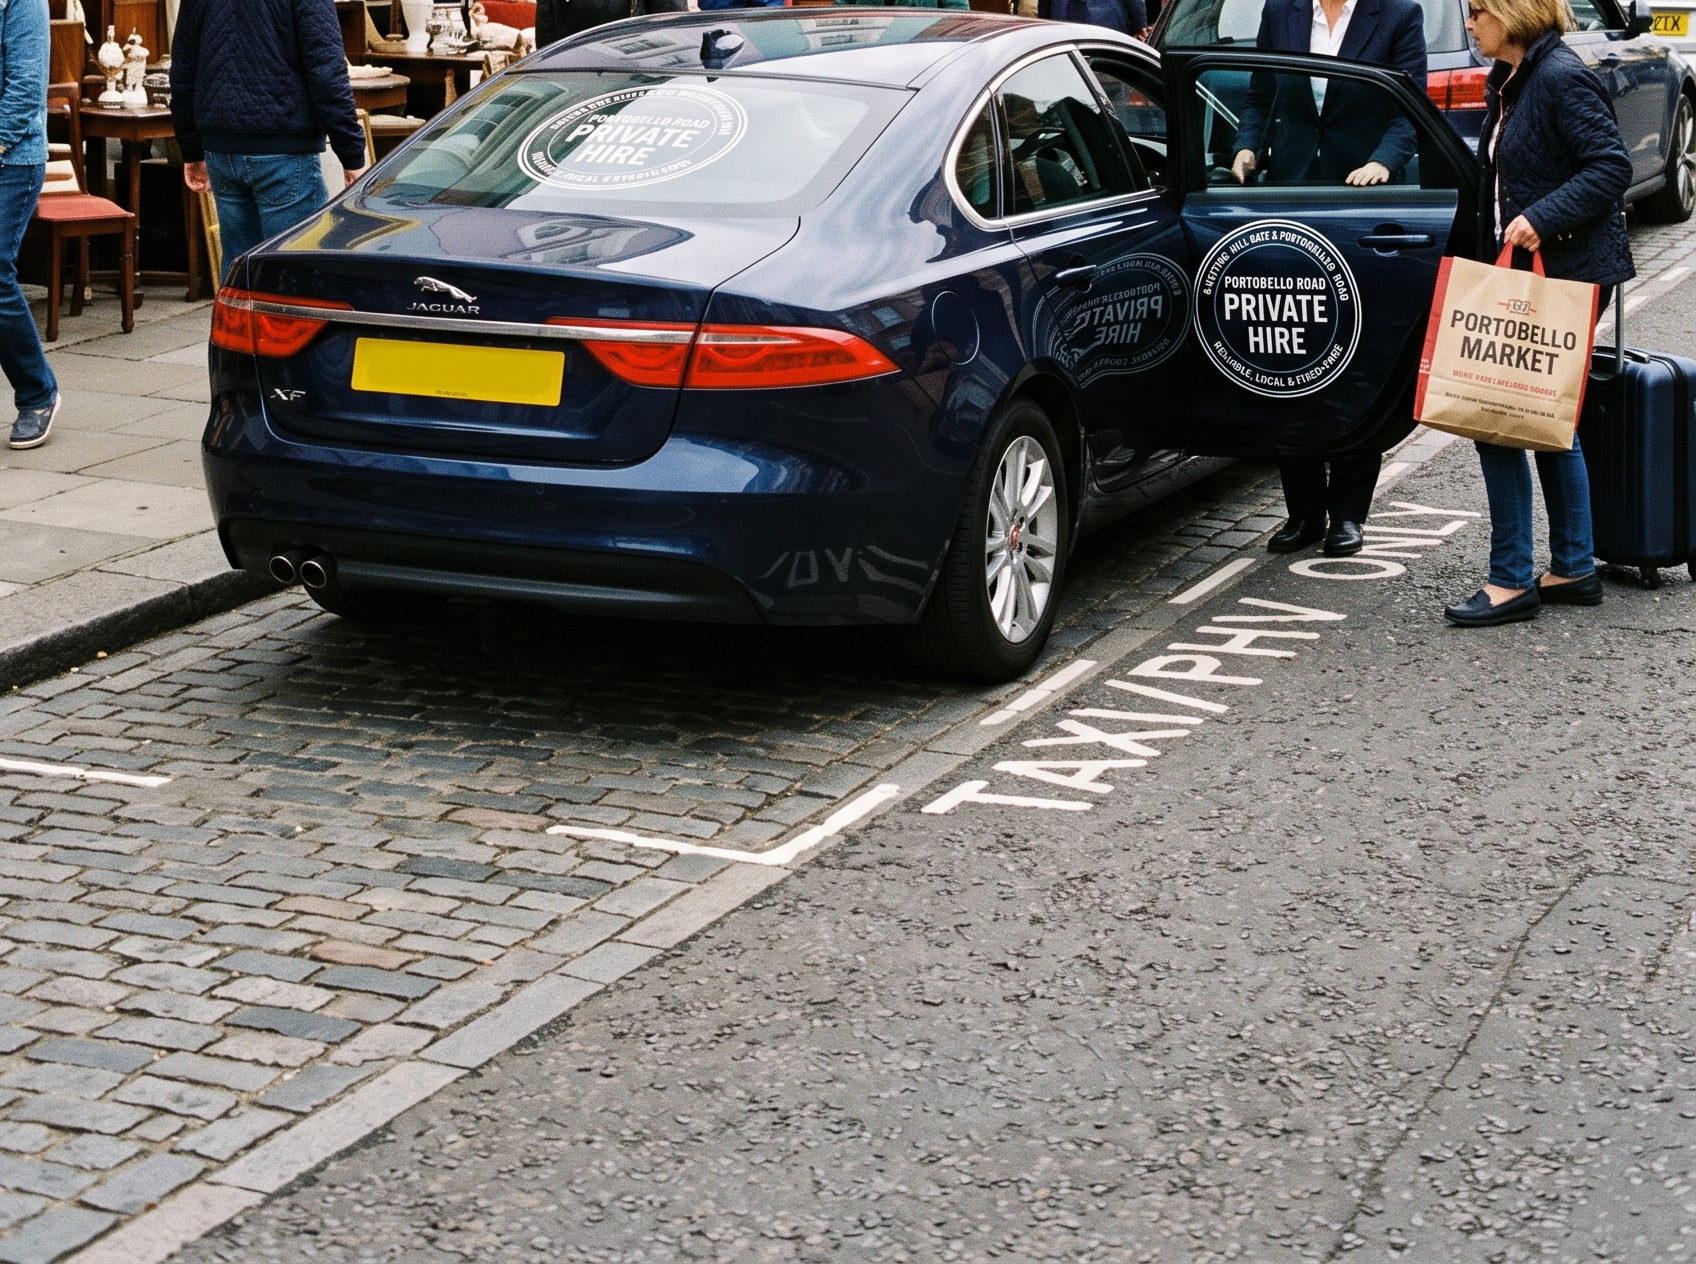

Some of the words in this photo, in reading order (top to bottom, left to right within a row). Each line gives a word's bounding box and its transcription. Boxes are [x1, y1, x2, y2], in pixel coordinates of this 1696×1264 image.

[671, 118, 711, 129] ROAD
[564, 124, 701, 148] PRIVATE
[574, 144, 656, 166] HIRE
[1224, 276, 1294, 290] PORTOBELLO
[1296, 277, 1326, 290] ROAD
[406, 302, 481, 315] JAGUAR
[1223, 292, 1328, 323] PRIVATE
[1248, 326, 1307, 355] HIRE
[1450, 309, 1577, 351] PORTOBELLO
[1460, 335, 1560, 376] MARKET
[270, 388, 306, 401] XF
[921, 597, 1347, 814] TAXI/PHV
[1288, 501, 1482, 580] ONLY
